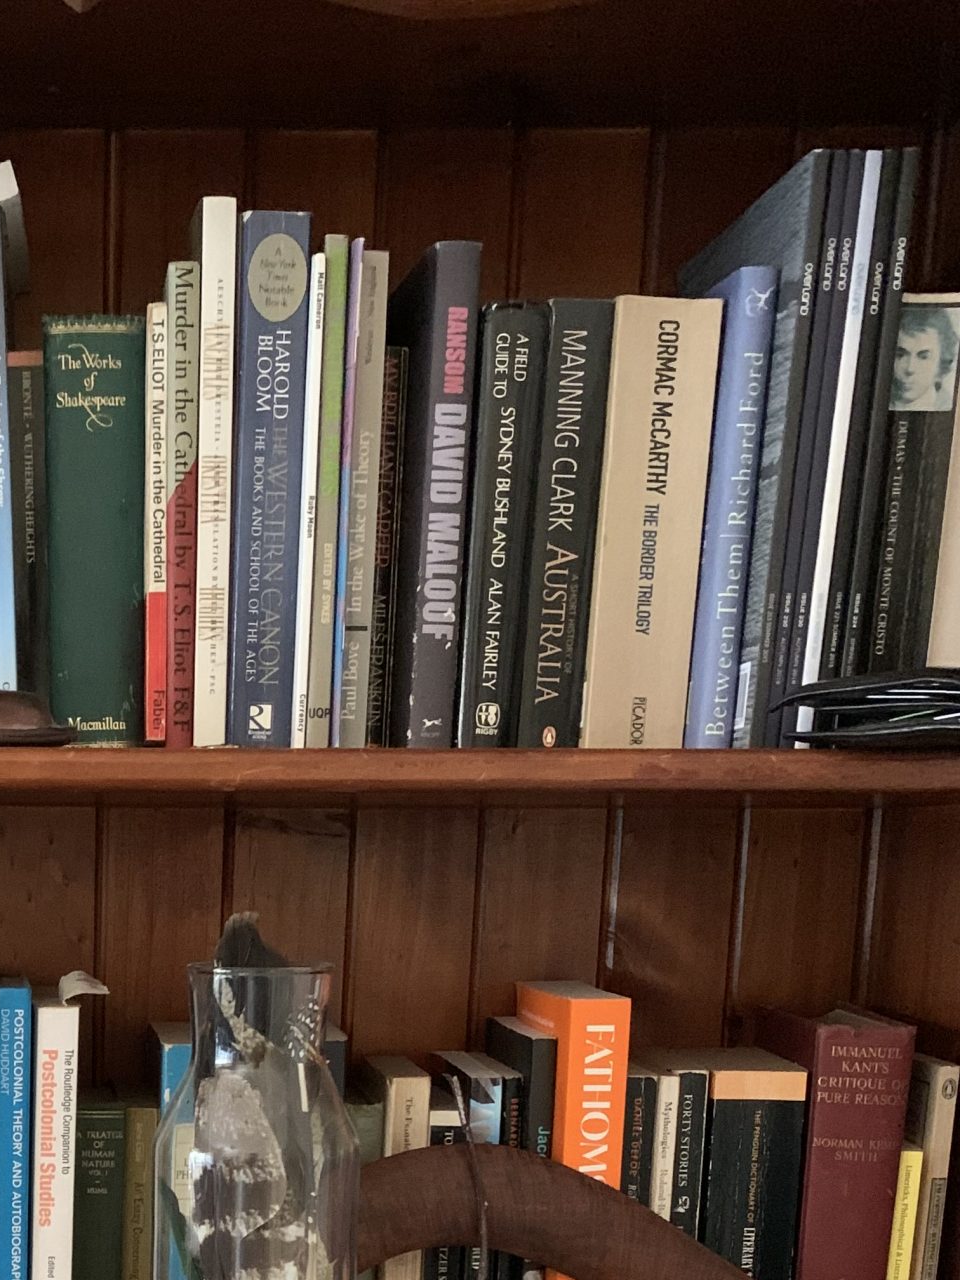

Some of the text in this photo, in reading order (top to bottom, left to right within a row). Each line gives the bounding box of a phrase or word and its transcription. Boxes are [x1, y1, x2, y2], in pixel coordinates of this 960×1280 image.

[58, 344, 123, 371] The Works
[255, 333, 274, 413] BLOOM
[273, 329, 292, 419] HAROLD
[442, 306, 469, 395] RANSOM
[492, 332, 511, 399] GUIDE TO
[513, 333, 530, 382] A FIELD
[56, 392, 127, 422] Shakespeare
[546, 329, 588, 532] MANNING CLARK
[725, 352, 764, 526] Richard Ford
[421, 403, 468, 641] DAVID MALOUF
[490, 405, 516, 569] SYDNEY BUSHLAND
[634, 319, 681, 636] CORMAC McCARTHY THE BORDER TRILOGY
[245, 426, 266, 683] THE BOOKS AND SCHOOL OF THE AGES
[481, 577, 504, 691] ALAN FAIRLEY
[533, 542, 580, 705] AUSTRALIA
[704, 543, 745, 737] Between Them
[67, 716, 126, 731] Macmillan
[295, 693, 306, 733] Currency
[629, 696, 648, 746] PICADOR
[12, 1008, 25, 1105] POSTCOLONIAL
[12, 1107, 24, 1157] THEORY
[39, 1048, 60, 1228] Postcolonial Studies
[60, 1049, 75, 1175] The Routledge Companion to
[11, 1159, 23, 1189] AND
[46, 1255, 57, 1279] Edited
